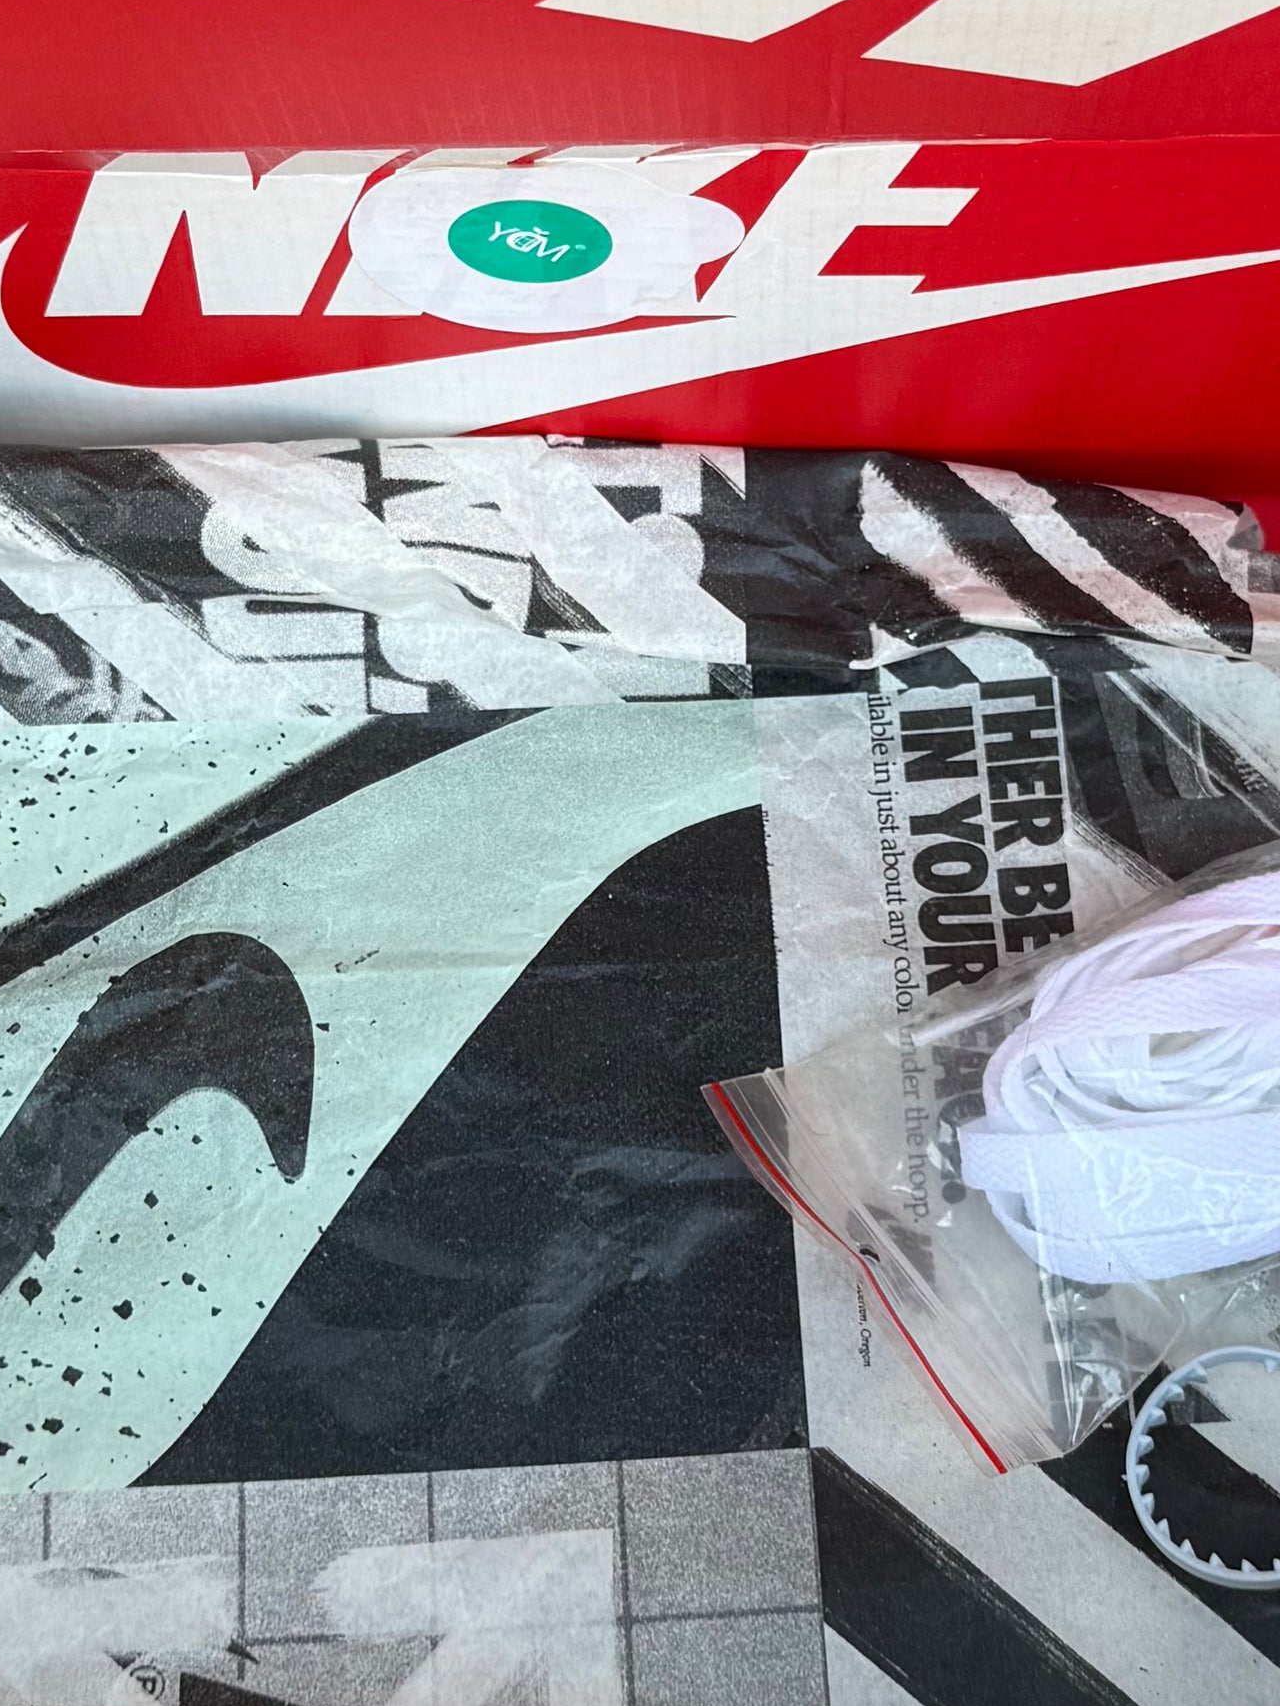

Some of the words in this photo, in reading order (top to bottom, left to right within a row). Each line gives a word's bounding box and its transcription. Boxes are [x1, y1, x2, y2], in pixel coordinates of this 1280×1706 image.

[867, 693, 892, 759] ilable
[900, 706, 978, 782] IN
[874, 761, 896, 786] in
[868, 788, 896, 834] just
[881, 839, 906, 905] about
[909, 794, 999, 996] YOUR
[884, 910, 907, 952] any
[905, 1101, 927, 1145] the
[858, 1327, 872, 1367] Oregon
